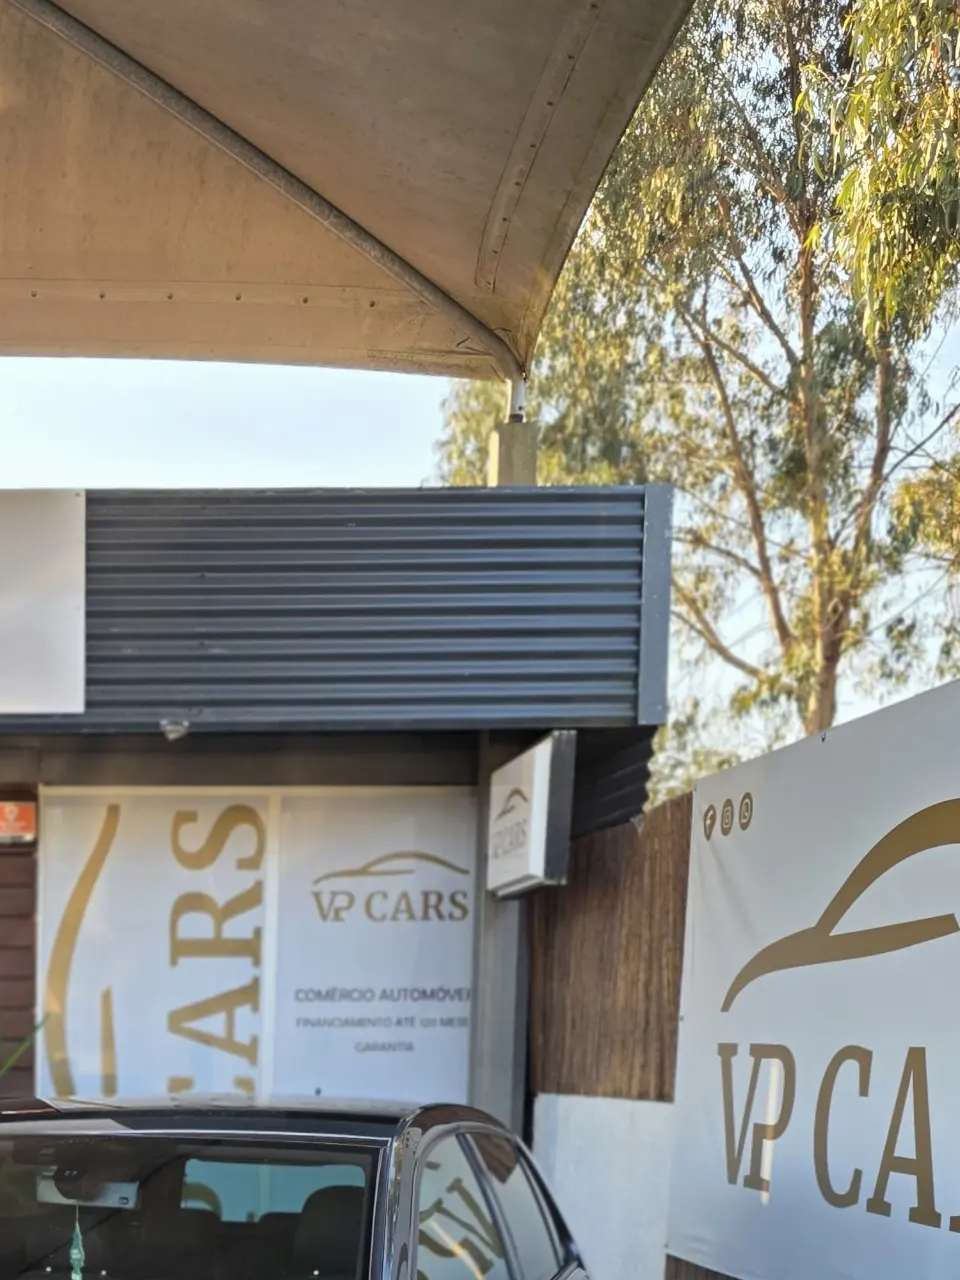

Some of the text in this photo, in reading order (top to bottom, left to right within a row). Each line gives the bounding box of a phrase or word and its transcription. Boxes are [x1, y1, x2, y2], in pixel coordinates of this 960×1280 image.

[167, 804, 268, 1094] ARS
[311, 889, 470, 923] VP CARS
[294, 984, 375, 1003] COMÉRCIO
[717, 1042, 960, 1234] VP CA
